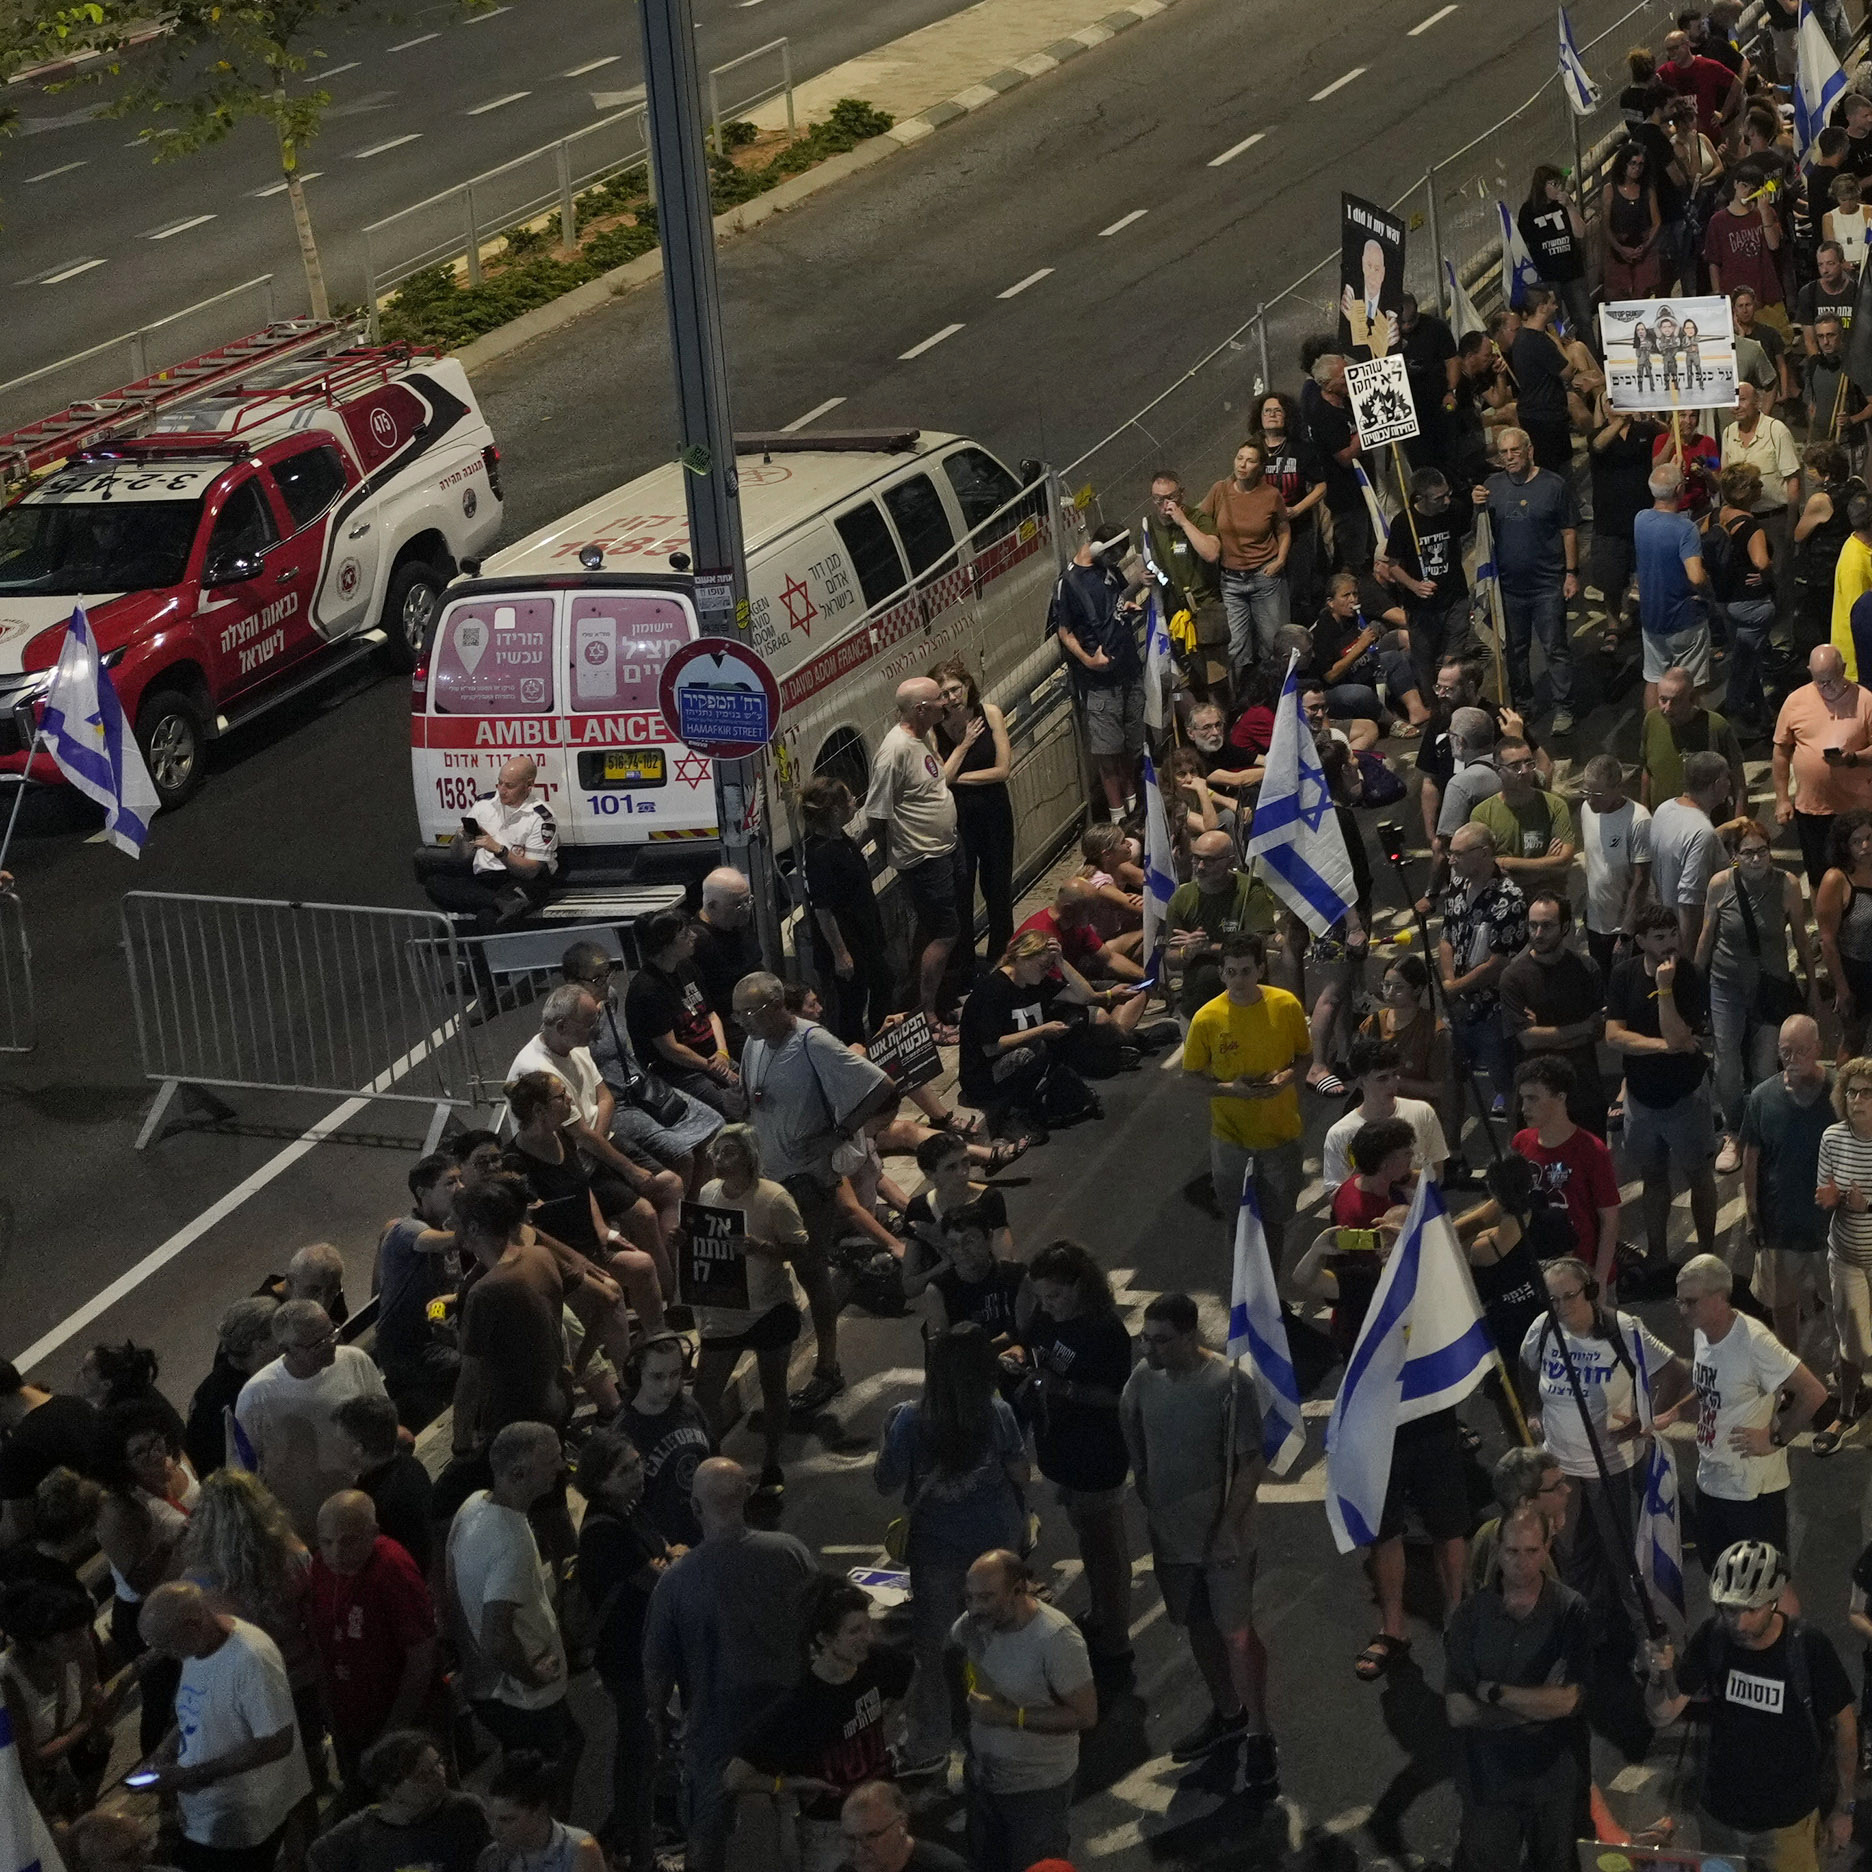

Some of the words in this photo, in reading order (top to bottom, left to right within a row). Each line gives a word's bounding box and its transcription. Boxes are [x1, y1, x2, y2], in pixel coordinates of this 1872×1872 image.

[1352, 205, 1365, 226] did
[1366, 211, 1374, 230] it
[1373, 217, 1386, 238] my
[1385, 223, 1401, 246] way
[1533, 209, 1566, 231] די
[1347, 360, 1383, 381] שהרס
[807, 562, 823, 581] דוד
[824, 552, 842, 569] מגן
[825, 571, 850, 594] אדום
[260, 591, 299, 629] כבאות
[818, 588, 855, 620] בישראל
[219, 616, 259, 654] והצלה
[496, 631, 544, 648] הורידו
[766, 632, 792, 657] ISRAEL
[239, 629, 286, 676] לישראל
[496, 649, 544, 666] עכשיו
[622, 635, 682, 660] מציל
[789, 669, 816, 699] DAVID
[814, 654, 838, 684] ADOM
[837, 636, 869, 671] FRANCE
[682, 691, 737, 711] המפקיר
[739, 694, 763, 713] רח'
[475, 716, 668, 747] AMBULANCE
[686, 722, 731, 737] HAMAFKIR
[732, 724, 764, 739] STREET
[444, 751, 479, 769] אדום
[436, 777, 478, 810] 1583
[587, 794, 636, 815] 101
[869, 1038, 889, 1059] אש
[899, 1025, 931, 1059] עכשיו
[704, 1213, 732, 1238] אל
[1730, 1677, 1779, 1706] כוסומו
